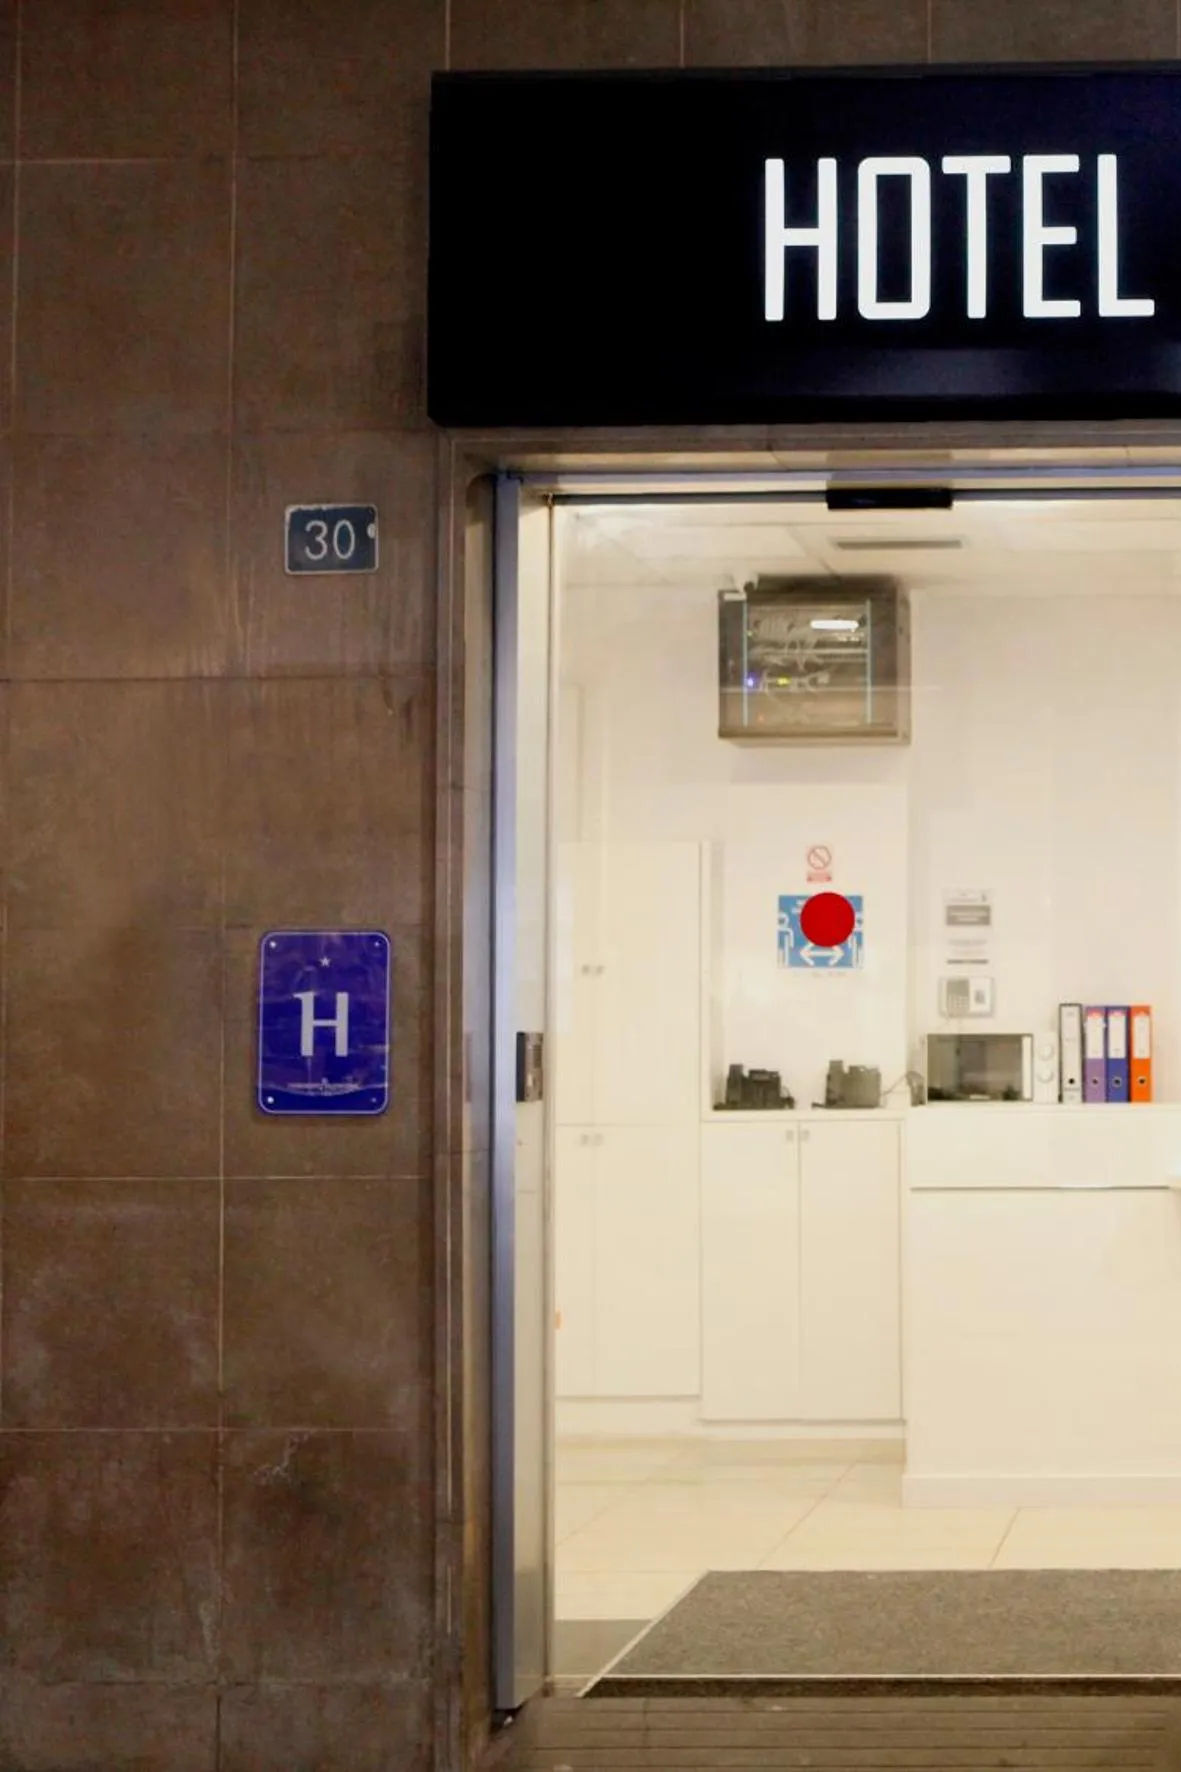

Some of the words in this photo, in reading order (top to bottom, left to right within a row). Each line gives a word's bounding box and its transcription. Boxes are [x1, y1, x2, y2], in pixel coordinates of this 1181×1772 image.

[766, 155, 1154, 320] HOTEL
[304, 519, 356, 560] 30
[301, 991, 350, 1057] H
